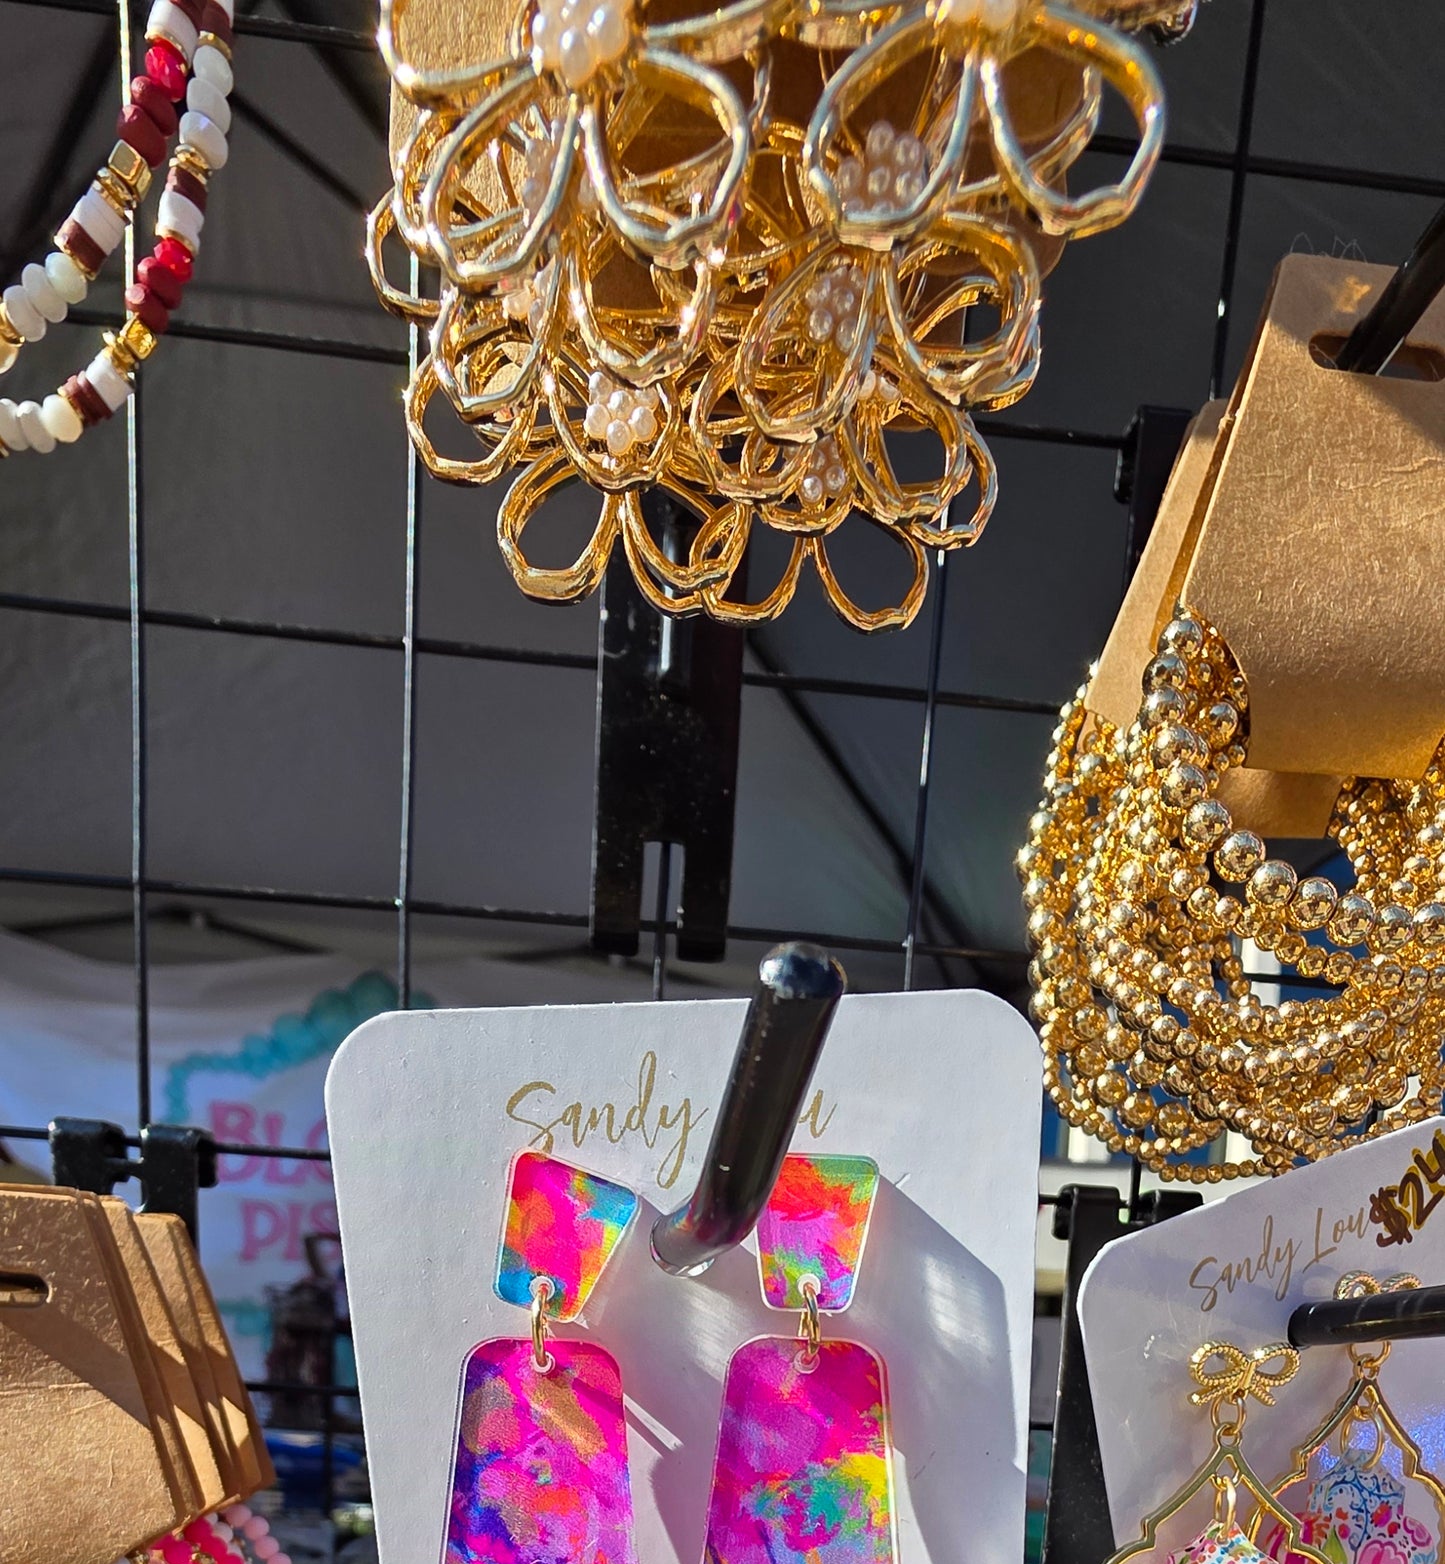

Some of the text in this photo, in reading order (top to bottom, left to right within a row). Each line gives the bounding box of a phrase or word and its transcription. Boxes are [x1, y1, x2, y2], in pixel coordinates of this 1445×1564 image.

[506, 1051, 709, 1188] Sandy
[1189, 1207, 1370, 1312] Sandy Lou
